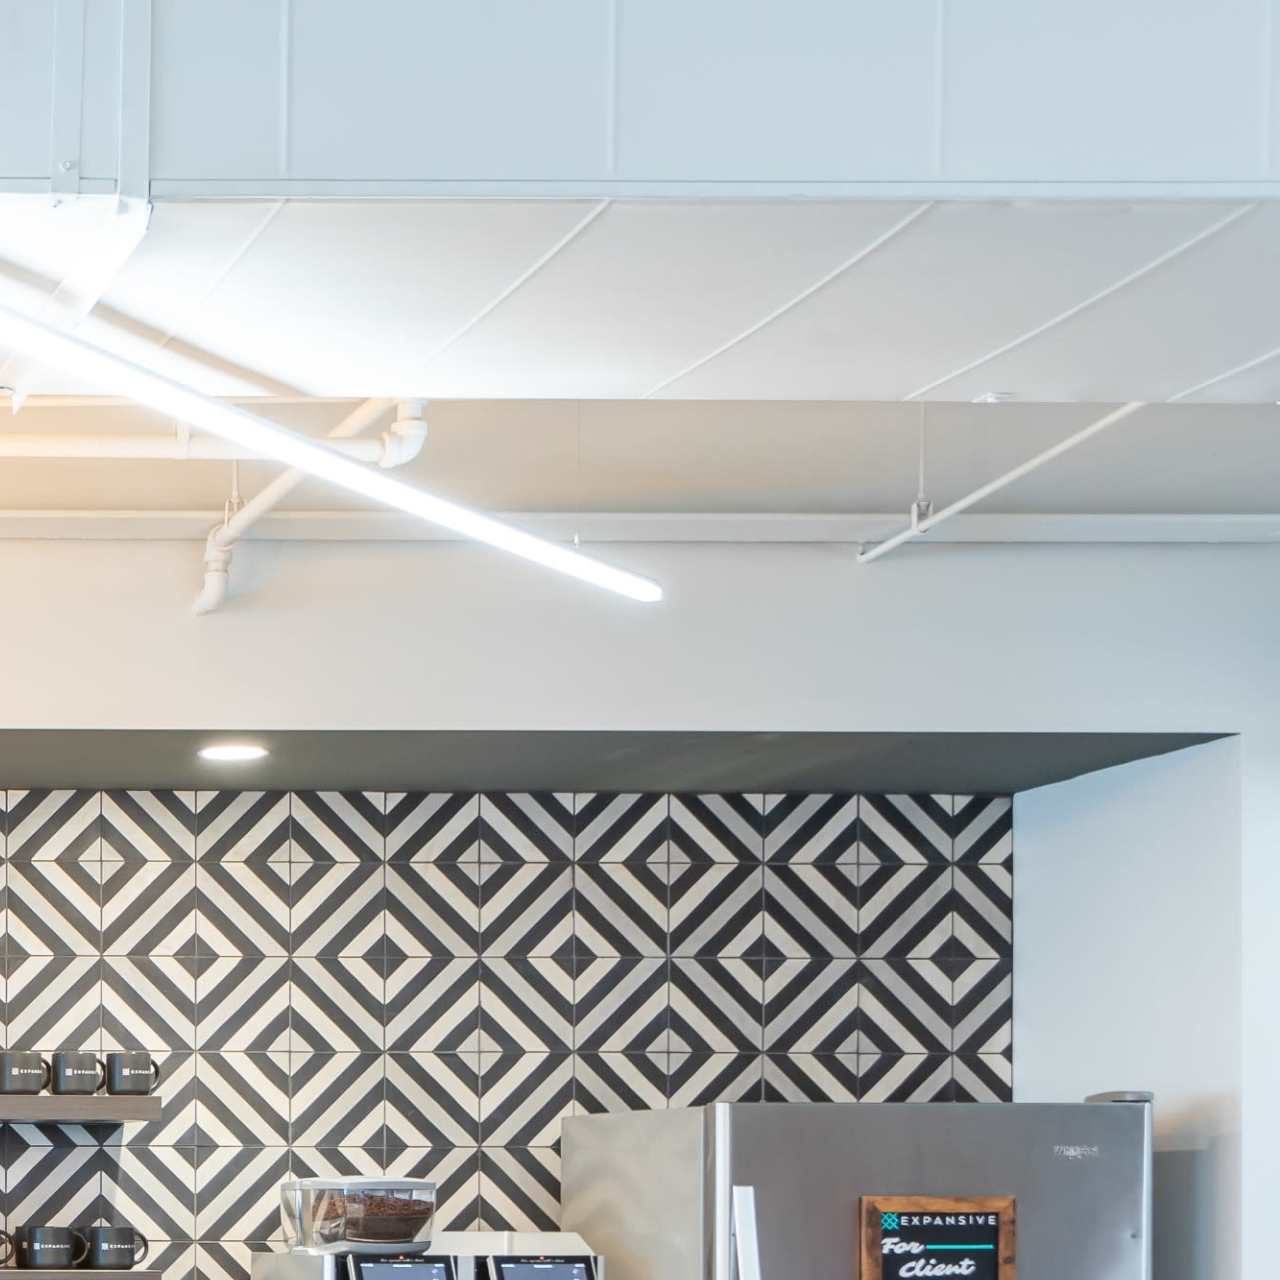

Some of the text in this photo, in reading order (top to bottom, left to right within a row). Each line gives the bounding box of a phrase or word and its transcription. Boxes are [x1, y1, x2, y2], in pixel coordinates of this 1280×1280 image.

[900, 1215, 997, 1226] EXPANSIVE
[880, 1237, 925, 1254] For
[898, 1258, 976, 1278] Client
